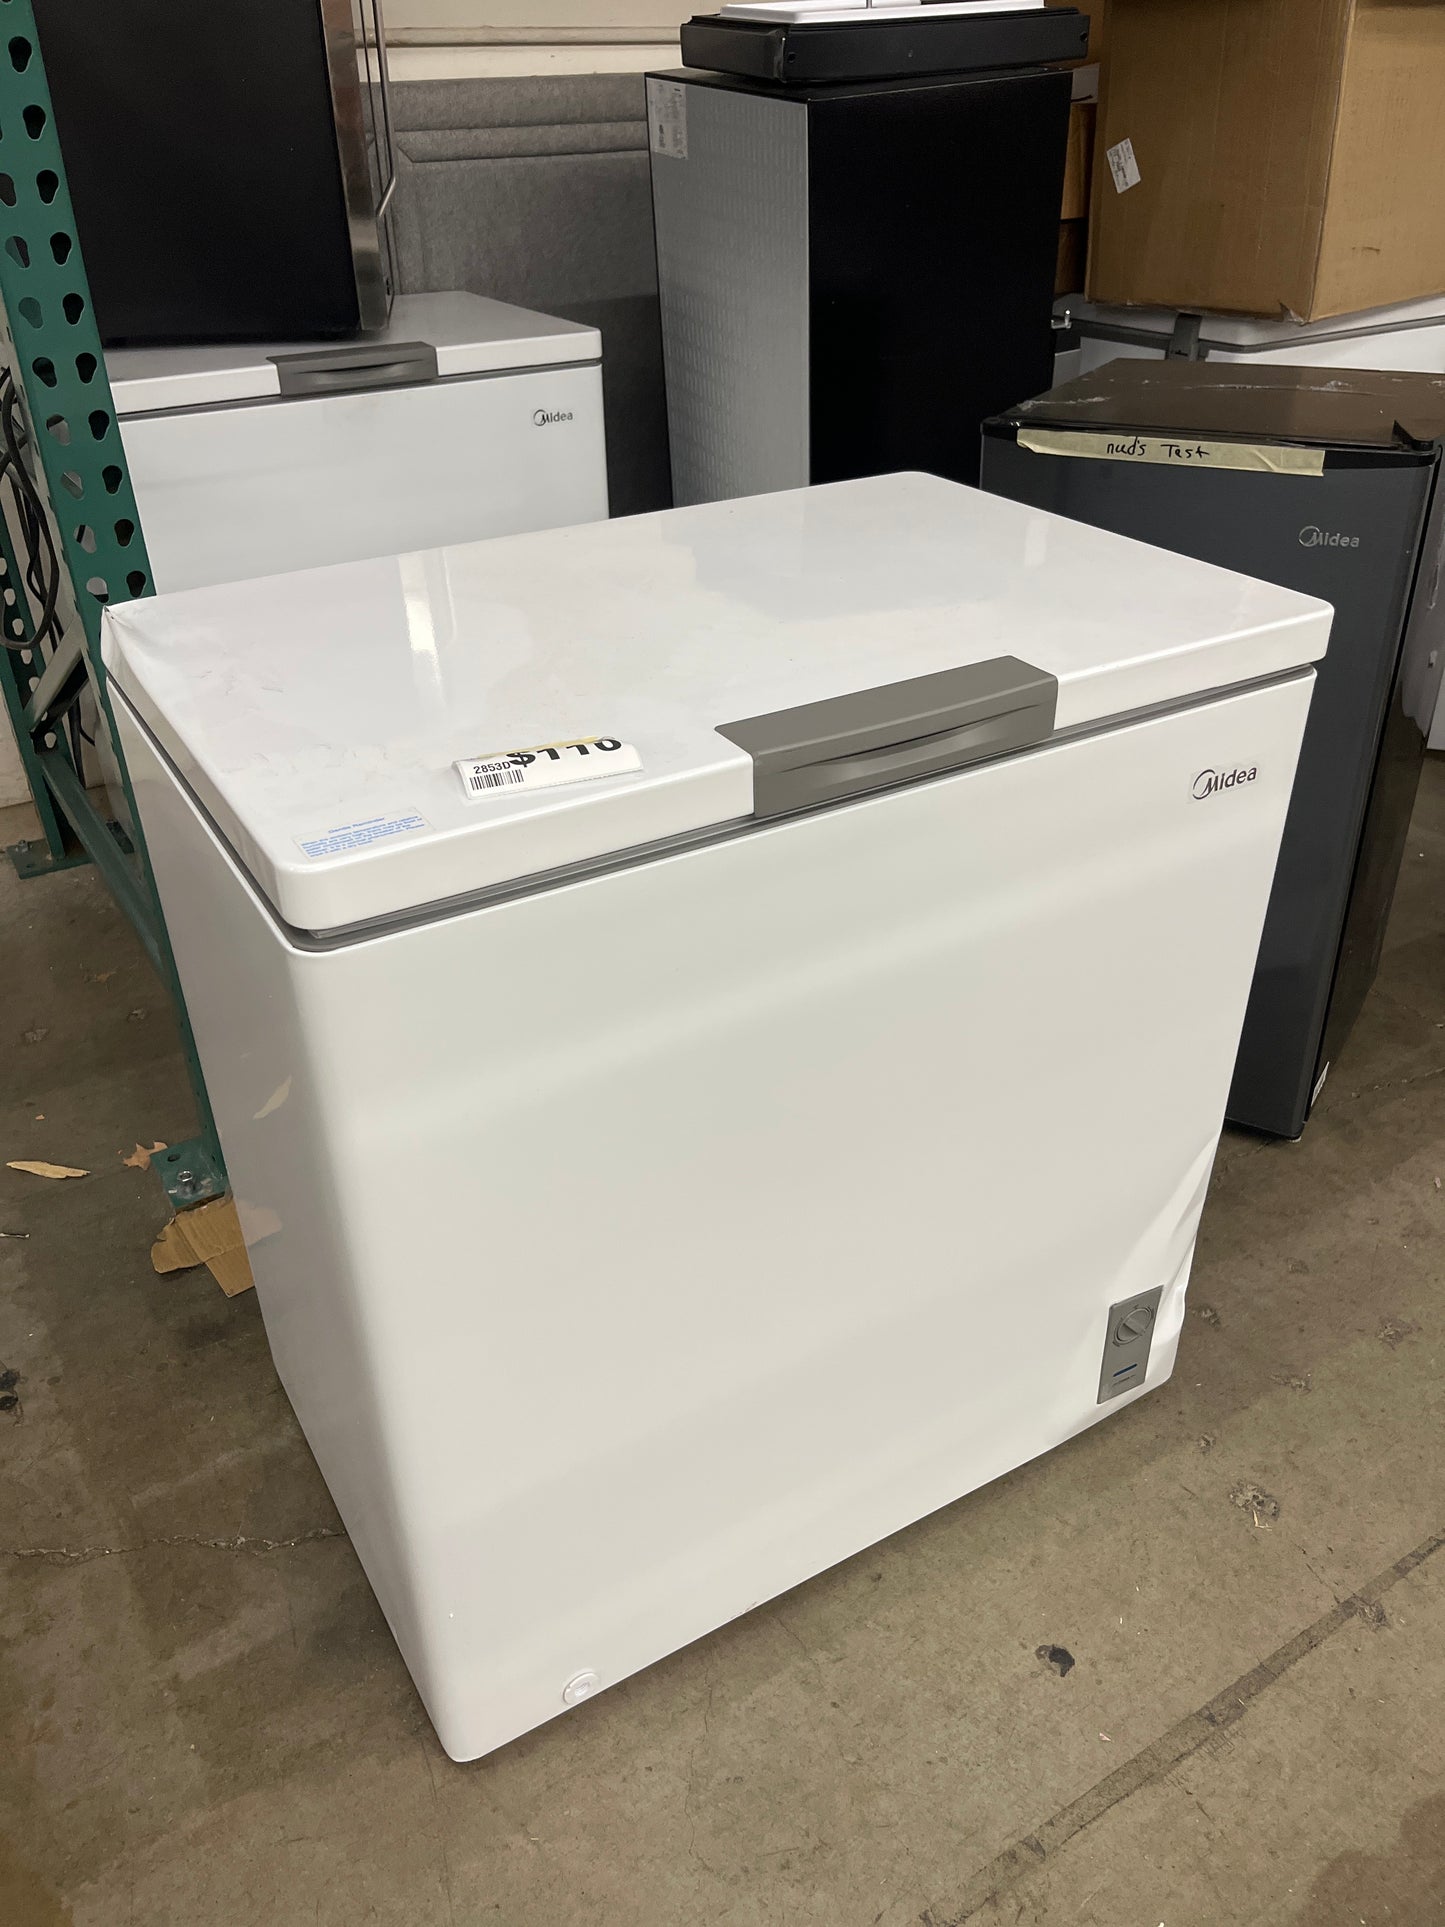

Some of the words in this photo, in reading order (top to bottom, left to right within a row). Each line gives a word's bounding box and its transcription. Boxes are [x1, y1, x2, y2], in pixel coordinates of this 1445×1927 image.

[533, 409, 573, 426] Midea
[1160, 444, 1210, 458] Test
[1299, 525, 1360, 547] Midea
[473, 761, 511, 774] 2853D
[1193, 767, 1257, 800] Midea
